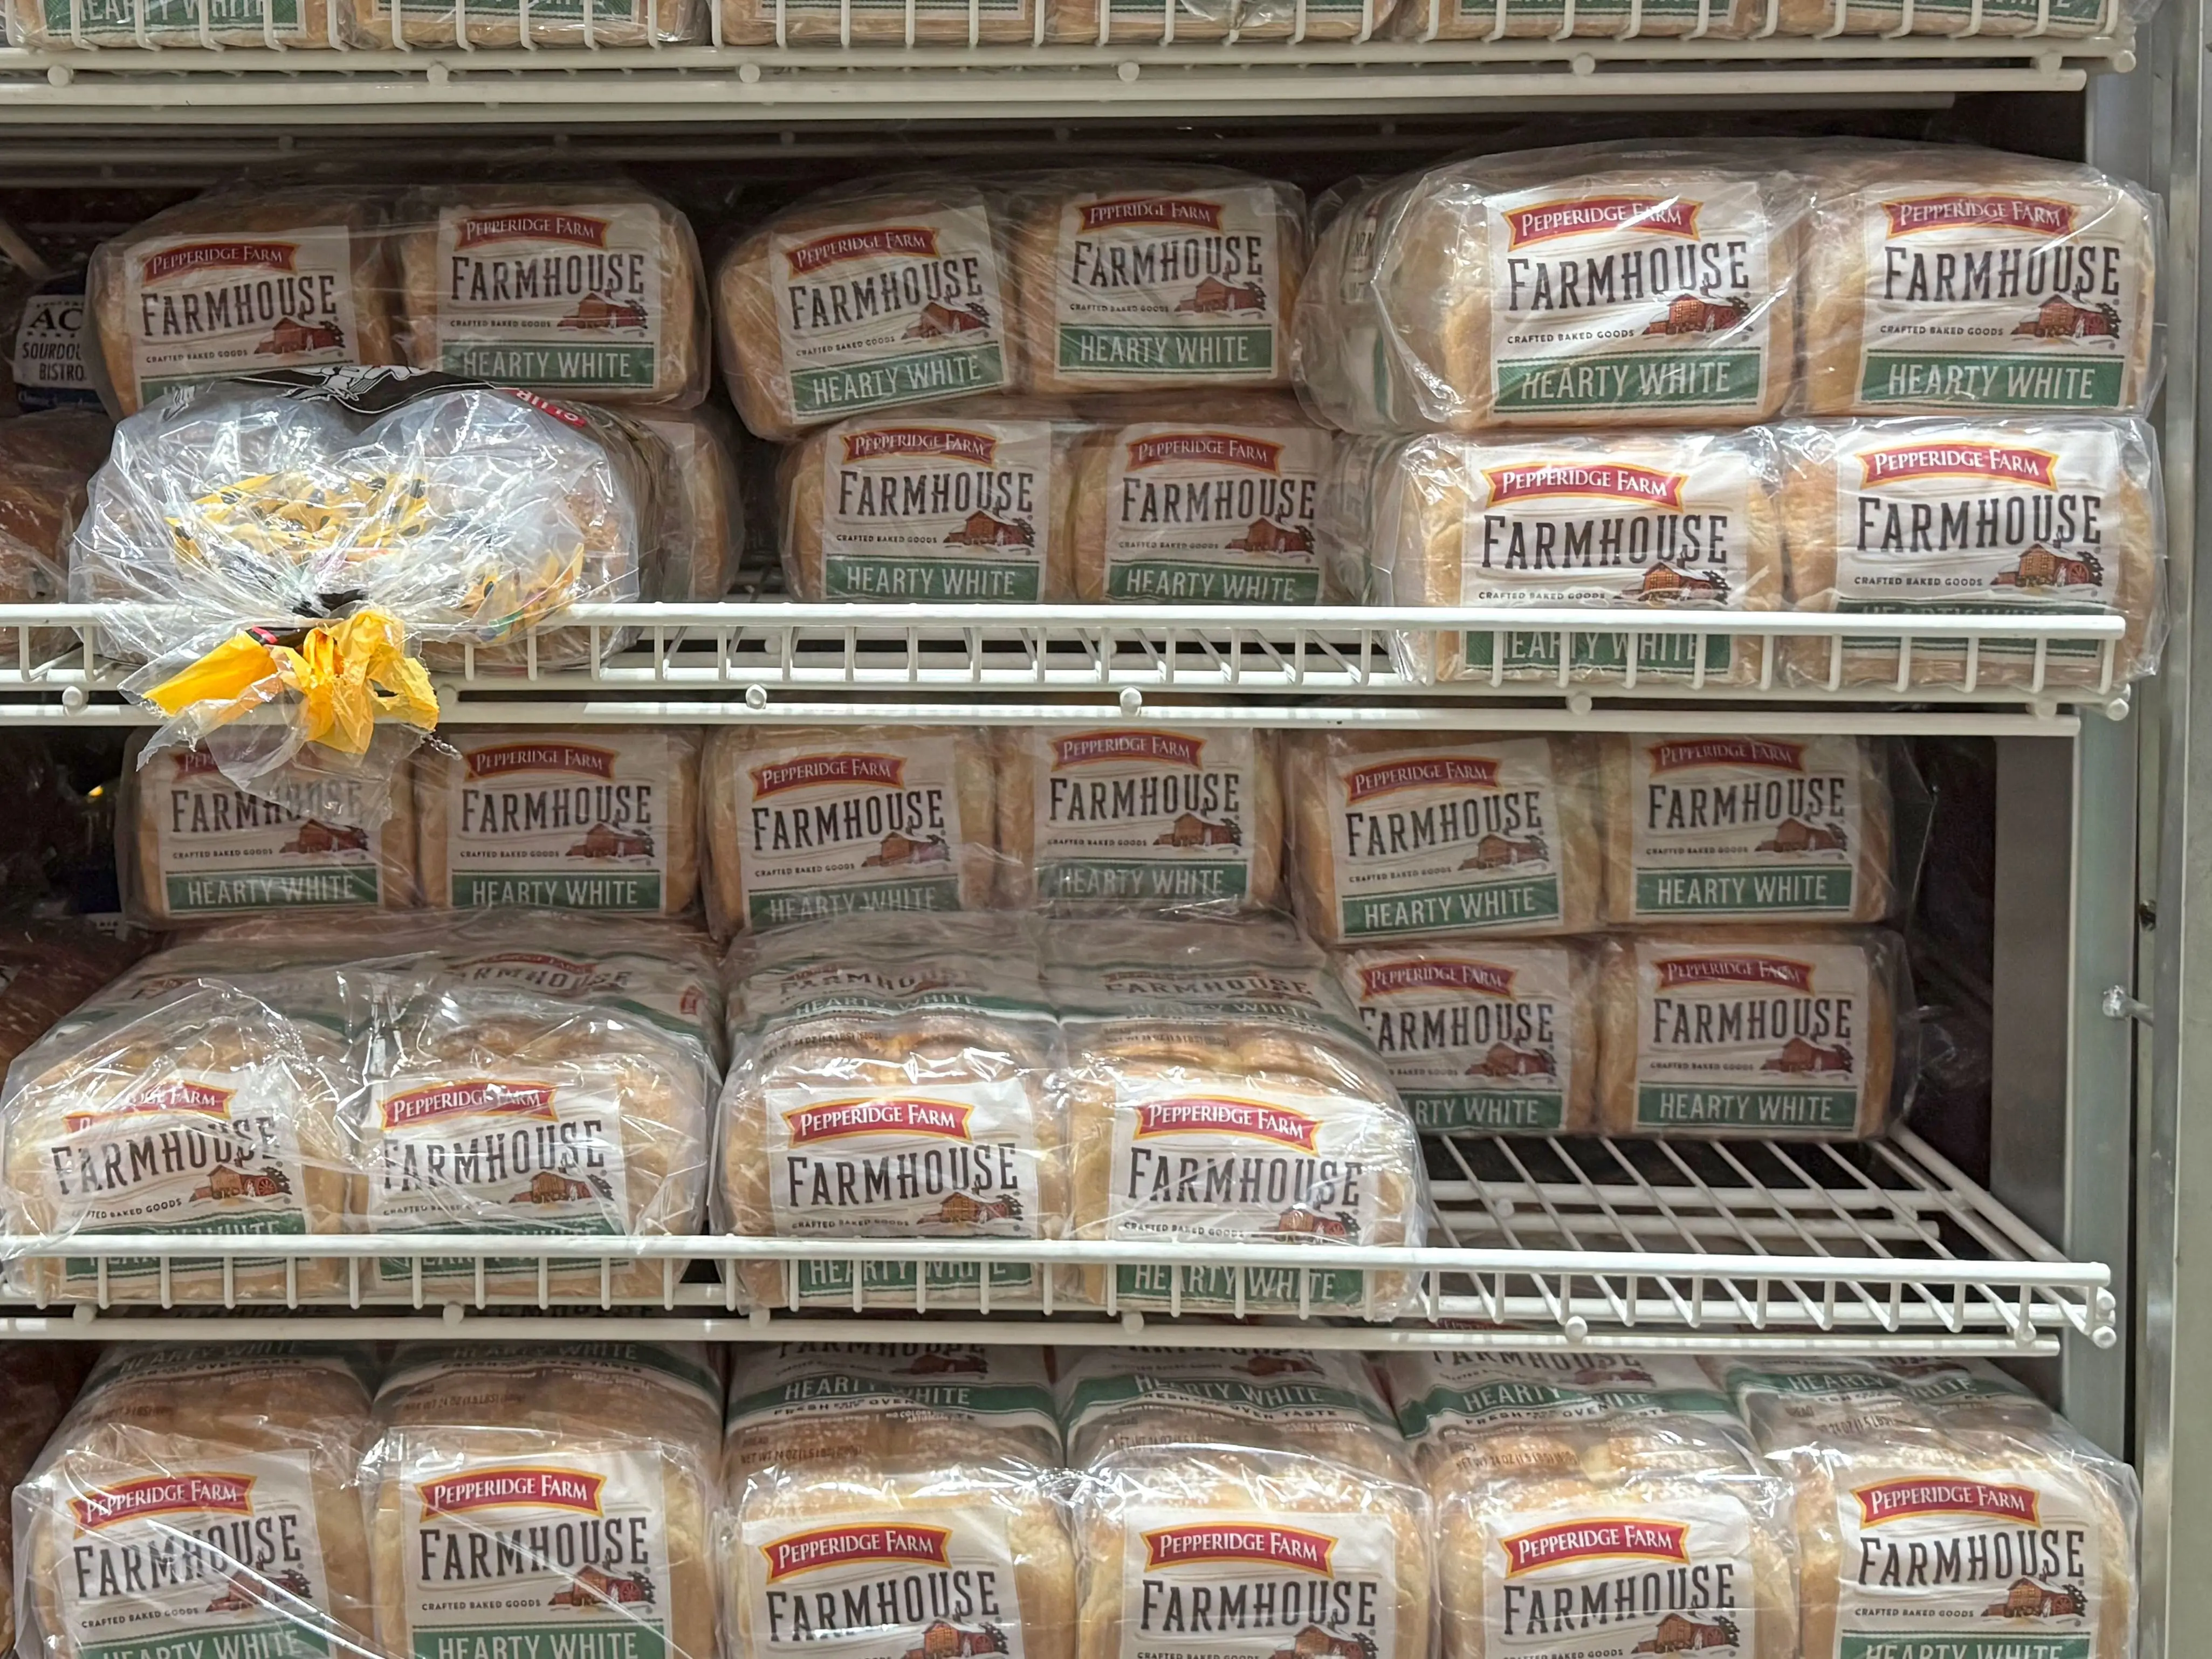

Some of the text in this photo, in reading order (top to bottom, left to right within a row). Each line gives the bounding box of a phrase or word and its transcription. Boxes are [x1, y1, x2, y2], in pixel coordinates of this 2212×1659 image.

[464, 217, 594, 240] PEPPERIDGE FARM
[1522, 205, 1626, 236] PEPPERIDGE
[1900, 201, 2062, 226] PEPPERIDGE FARM
[153, 245, 283, 274] PEPPERIDGE FARM
[796, 232, 926, 268] PEPPERIDGE FARM
[1072, 236, 1263, 287] FARMHOUSE
[452, 253, 644, 301] FARMHOUSE
[1508, 241, 1749, 311] FARMHOUSE
[1885, 246, 2120, 301] FARMHOUSE
[141, 275, 337, 336] FARMHOUSE
[788, 257, 983, 330] FARMHOUSE
[1508, 329, 1634, 344] CRAFTED BAKED GOODS
[1880, 325, 2003, 336] CRAFTED BAKED GOODS
[463, 352, 631, 378] HEARTY WHITE
[1080, 336, 1248, 363] HEARTY WHITE
[814, 355, 981, 406] HEARTY WHITE
[1521, 362, 1730, 400] HEARTY WHITE
[1888, 364, 2095, 399] HEARTY WHITE
[855, 433, 985, 455] PEPPERIDGE FARM
[1139, 439, 1267, 462] PEPPERIDGE FARM
[1874, 449, 2039, 476] PEPPERIDGE FARM
[839, 471, 1033, 516] FARMHOUSE
[1503, 468, 1667, 497] PEPPERIDGE FARM
[1122, 477, 1316, 522] FARMHOUSE
[1857, 494, 2101, 552] FARMHOUSE
[1482, 514, 1727, 569] FARMHOUSE
[847, 566, 1016, 596] HEARTY WHITE
[1126, 569, 1296, 602] HEARTY WHITE
[1479, 591, 1605, 600] CRAFTED BAKED GOODS
[1854, 576, 1982, 586] CRAFTED BAKED GOODS
[477, 749, 603, 772] PEPPERIDGE FARM
[1064, 736, 1190, 759] PEPPERIDGE FARM
[762, 758, 891, 788] PEPPERIDGE FARM
[1355, 761, 1487, 794] PEPPERIDGE FARM
[461, 785, 651, 833] FARMHOUSE
[1050, 773, 1239, 821] FARMHOUSE
[1648, 777, 1845, 829] FARMHOUSE
[752, 789, 944, 851] FARMHOUSE
[1345, 791, 1542, 857] FARMHOUSE
[187, 875, 355, 905] HEARTY WHITE
[472, 880, 637, 906] HEARTY WHITE
[1058, 869, 1224, 894] HEARTY WHITE
[1658, 875, 1828, 905] HEARTY WHITE
[1364, 887, 1536, 929] HEARTY WHITE
[1462, 965, 1502, 987] FARM
[1653, 998, 1852, 1044] FARMHOUSE
[170, 1085, 216, 1107] FARM
[1464, 1097, 1538, 1125] WHITE
[1660, 1092, 1833, 1121] HEARTY WHITE
[801, 1104, 954, 1135] PEPPERIDGE FARM
[1149, 1104, 1303, 1139] PEPPERIDGE FARM
[383, 1119, 604, 1192] FARMHOUSE
[787, 1142, 1018, 1207] FARMHOUSE
[1128, 1147, 1363, 1207] FARMHOUSE
[146, 1197, 182, 1213] GOODS
[792, 1219, 910, 1229] CRAFTED BAKED GOODS
[1240, 1386, 1325, 1407] WHITE
[1462, 1384, 1562, 1412] HEARTY
[86, 1479, 237, 1523] PEPPERIDGE FARM
[434, 1474, 587, 1508] PEPPERIDGE FARM
[1871, 1485, 2025, 1515] PEPPERIDGE FARM
[73, 1514, 300, 1598] FARMHOUSE
[420, 1516, 648, 1581] FARMHOUSE
[779, 1529, 934, 1569] PEPPERIDGE FARM
[1160, 1531, 1317, 1562] PEPPERIDGE FARM
[1518, 1525, 1672, 1563] PEPPERIDGE FARM
[1858, 1529, 2085, 1586] FARMHOUSE
[422, 1599, 542, 1611] CRAFTED BAKED GOODS
[766, 1569, 1000, 1642] FARMHOUSE
[1141, 1579, 1377, 1632] FARMHOUSE
[1503, 1562, 1735, 1635] FARMHOUSE
[1854, 1607, 1974, 1619] CRAFTED BAKED GOODS
[81, 1607, 199, 1628] CRAFTED BAKED GOODS
